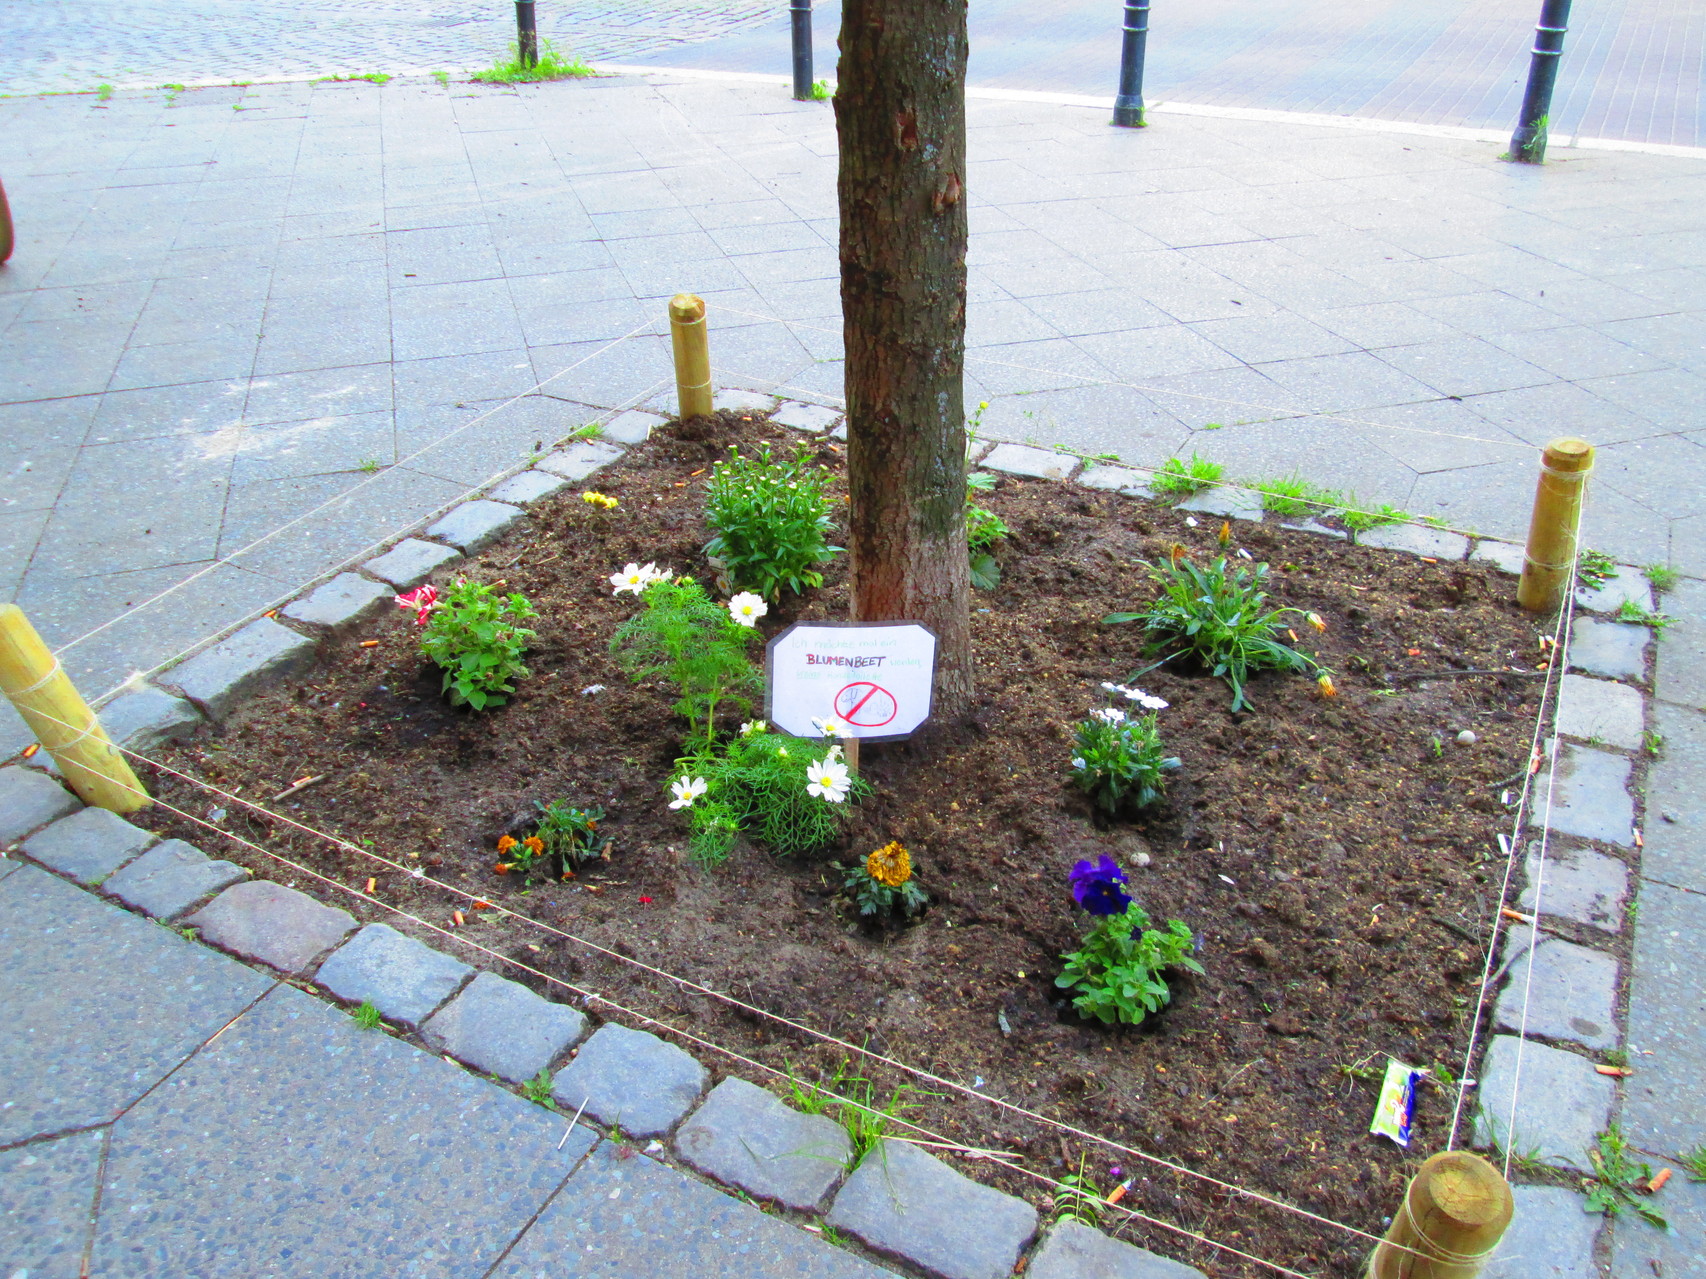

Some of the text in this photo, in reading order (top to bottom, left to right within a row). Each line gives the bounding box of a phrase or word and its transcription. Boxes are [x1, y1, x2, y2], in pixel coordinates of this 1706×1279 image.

[859, 638, 877, 648] mal
[880, 636, 897, 648] ein
[805, 654, 886, 669] BLUMENBEET
